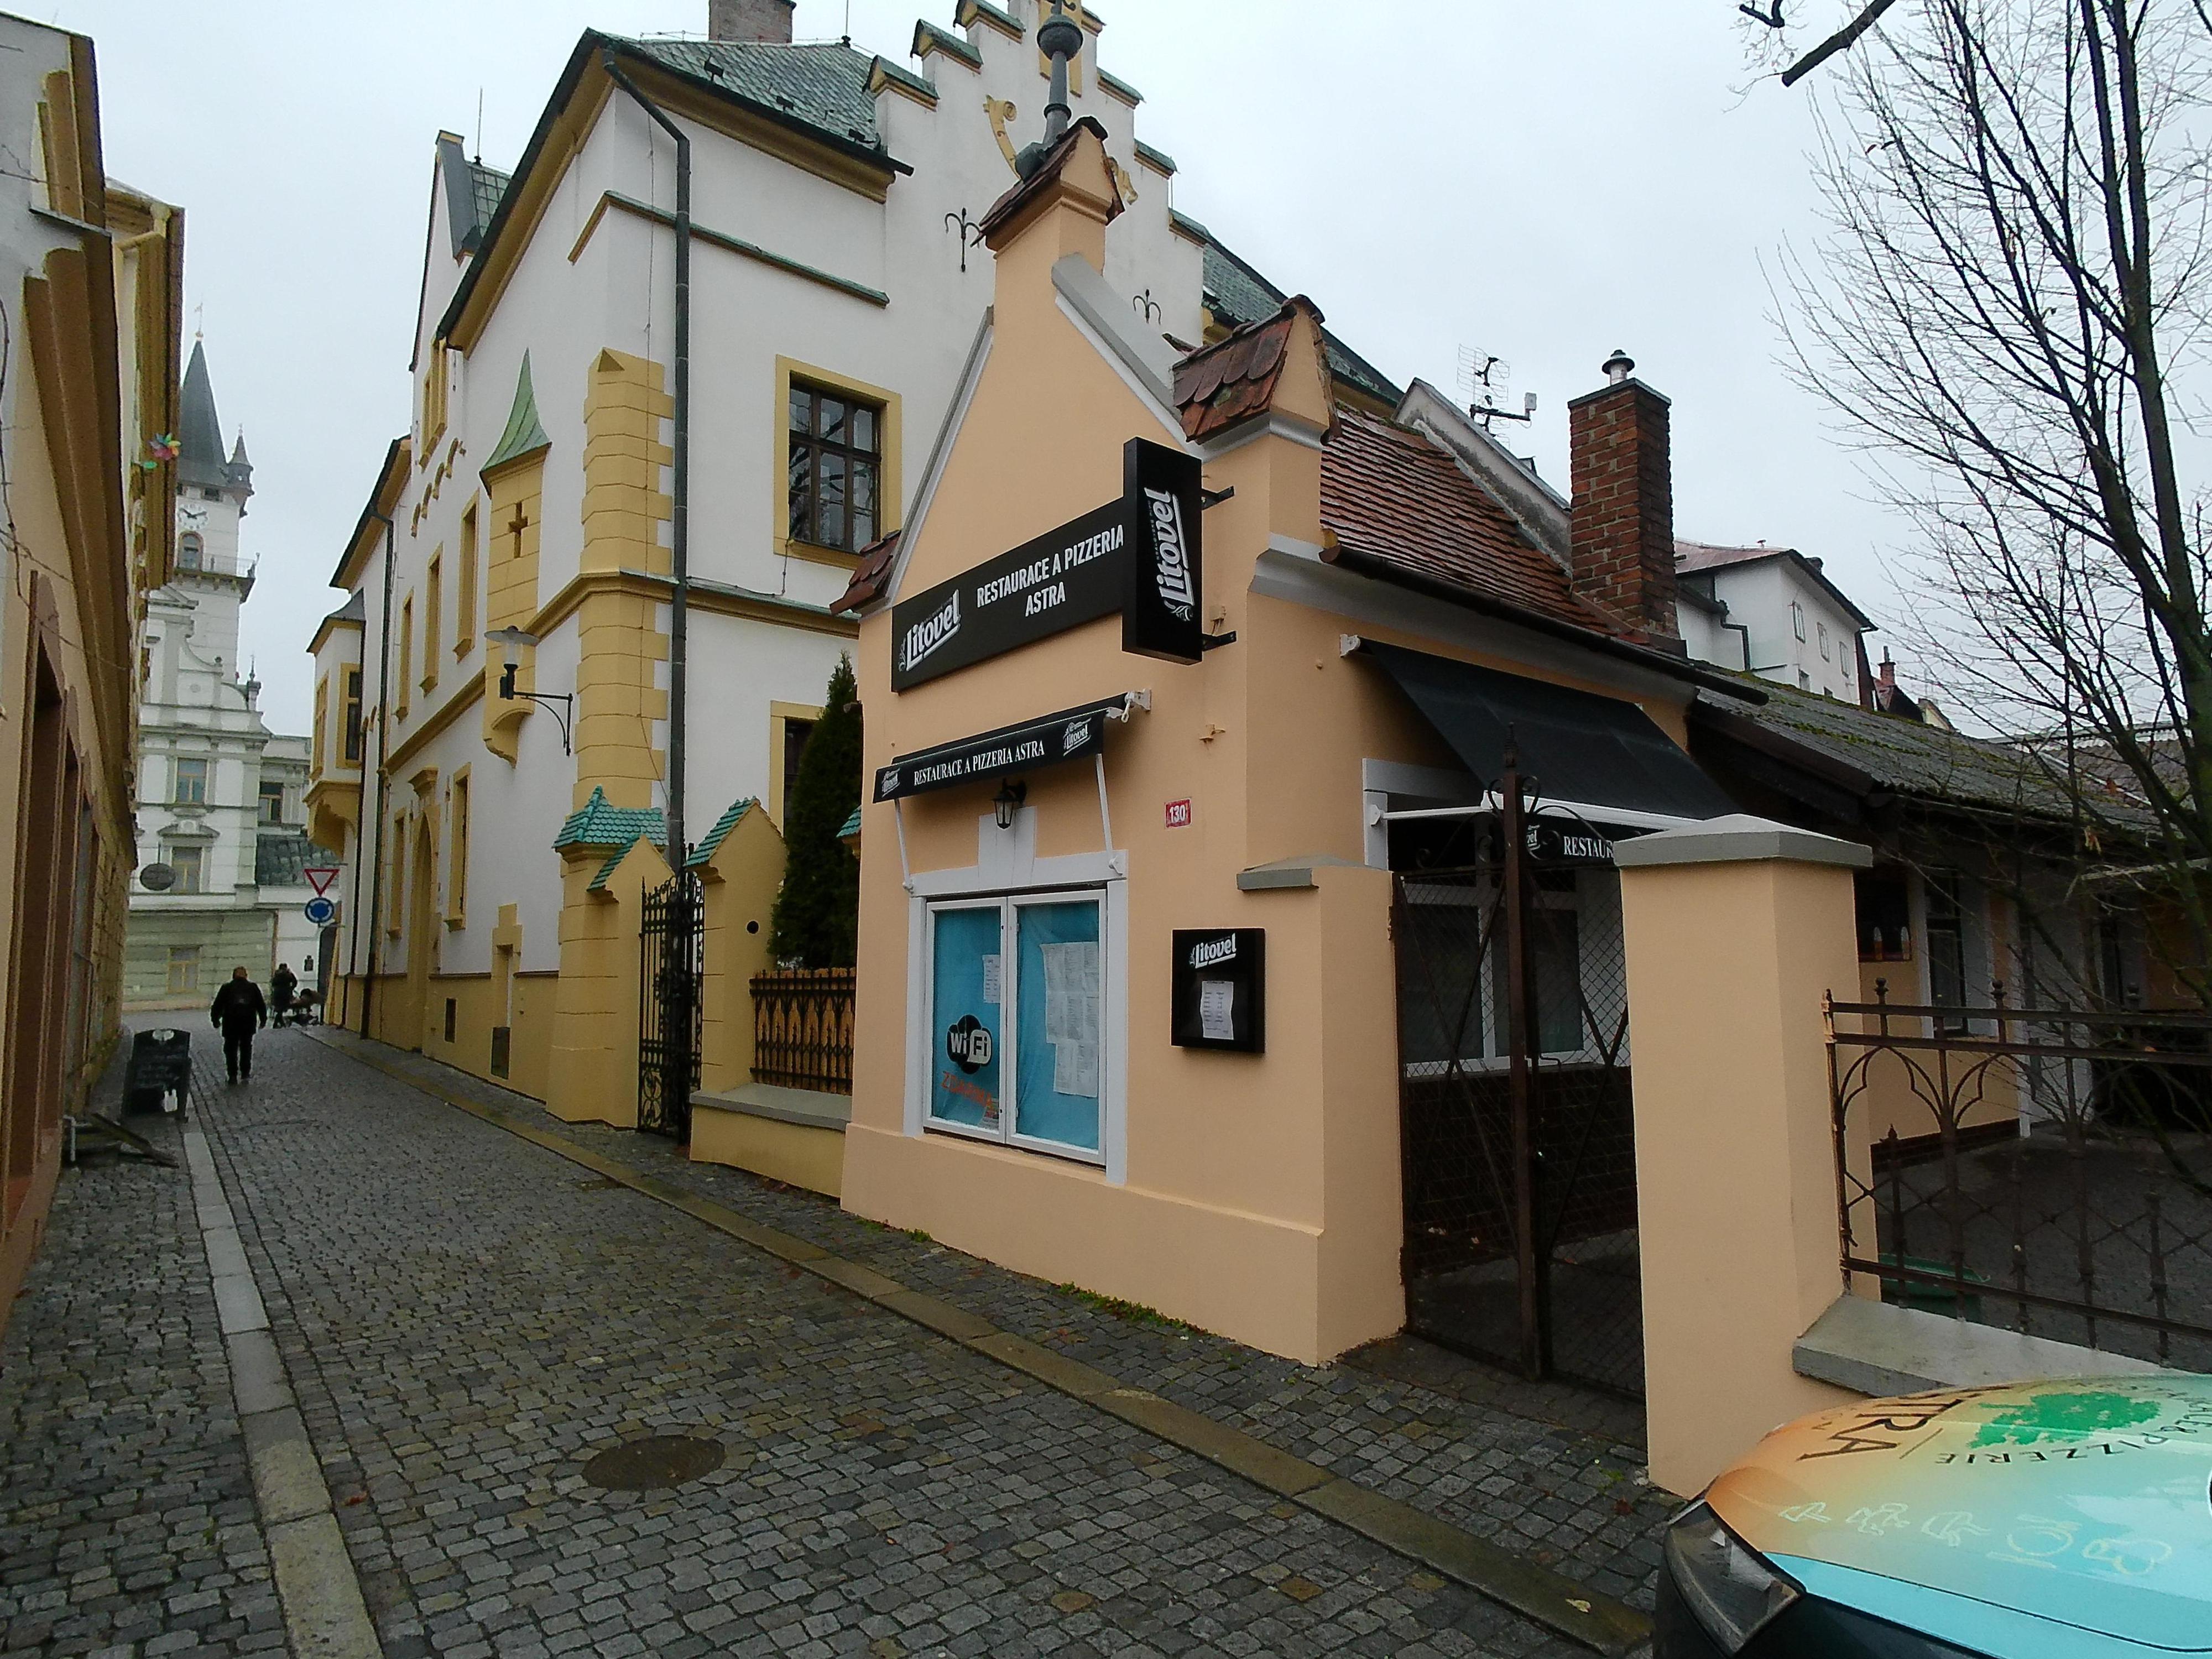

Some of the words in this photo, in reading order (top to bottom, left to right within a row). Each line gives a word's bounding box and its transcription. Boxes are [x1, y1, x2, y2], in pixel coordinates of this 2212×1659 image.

[977, 557, 1050, 608] RESTAURACE
[1052, 553, 1062, 576] A
[1064, 524, 1124, 570] PIZZERIA
[1144, 487, 1194, 606] Litovel
[1025, 582, 1066, 617] ASTRA
[906, 588, 961, 671] Litovel
[914, 759, 962, 786] RESTAURACE
[964, 758, 971, 774] A
[973, 747, 1013, 771] PIZZERIA
[1014, 740, 1045, 761] ASTRA
[1169, 805, 1186, 823] 130
[1194, 933, 1237, 969] Litovel
